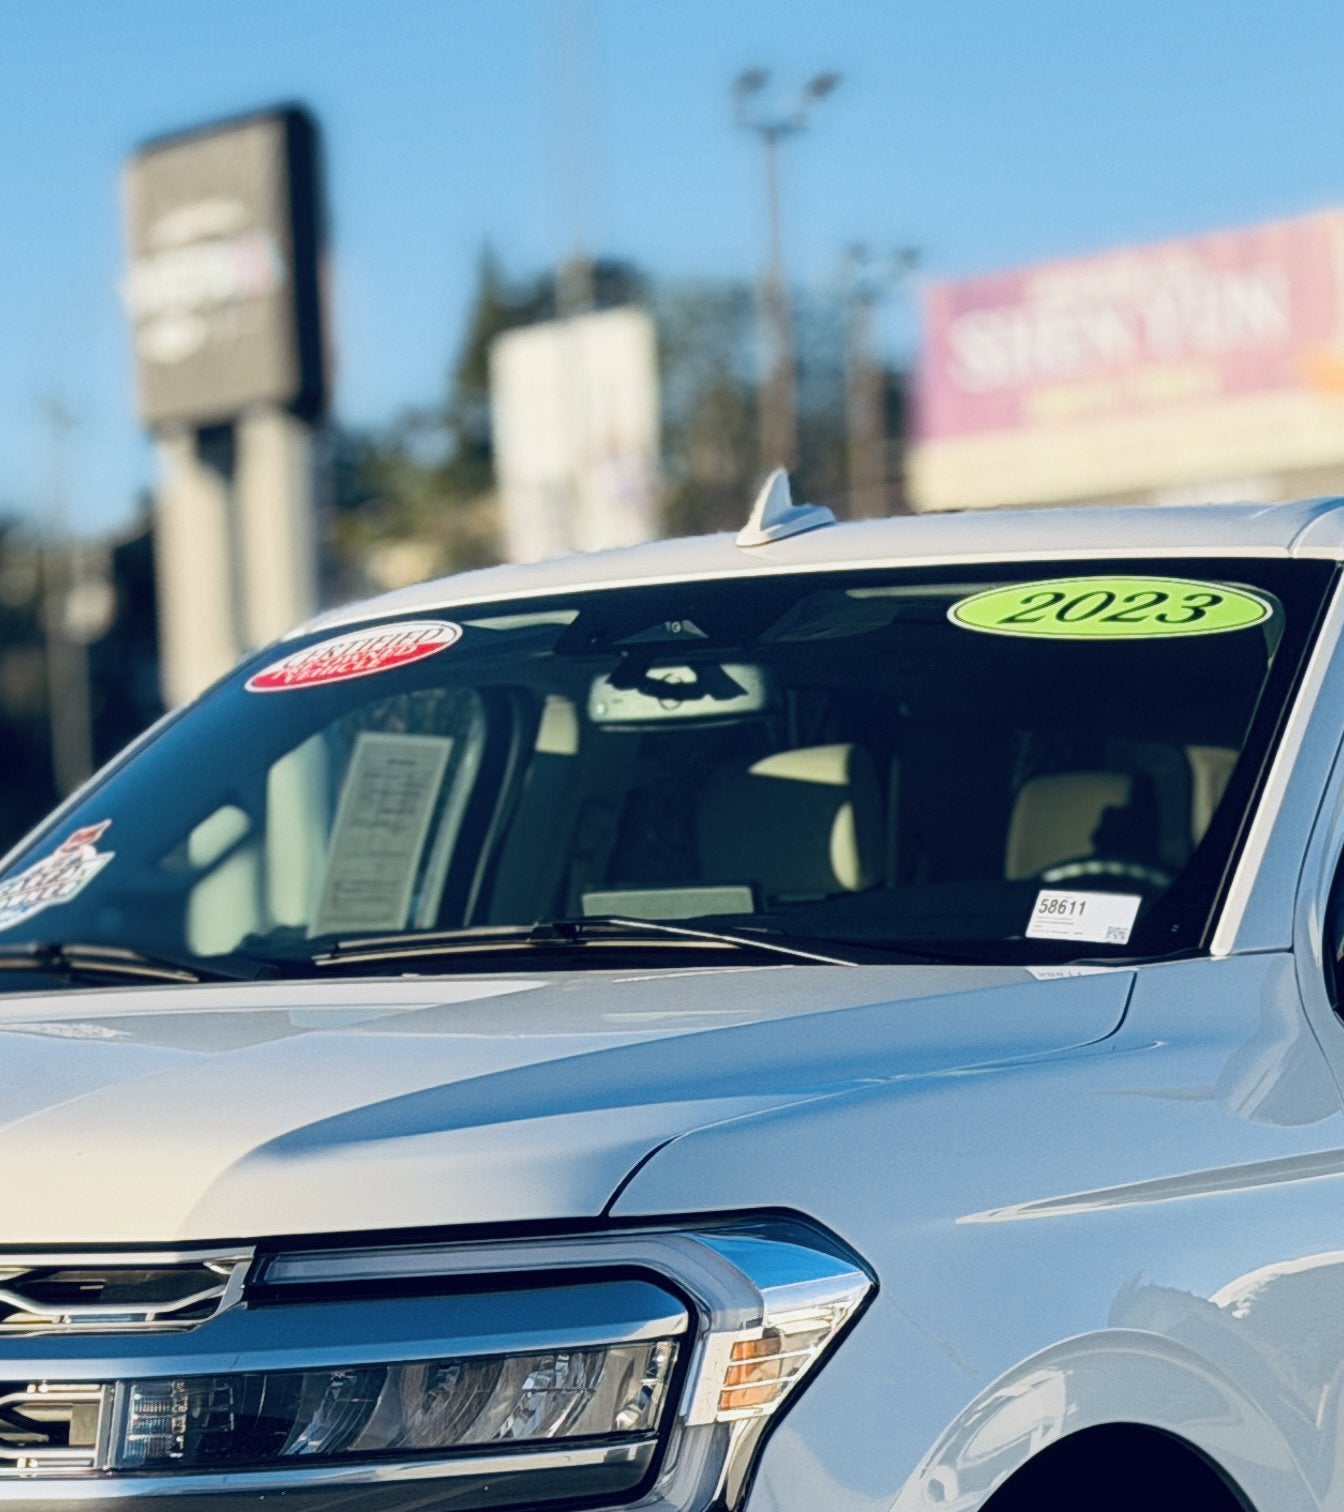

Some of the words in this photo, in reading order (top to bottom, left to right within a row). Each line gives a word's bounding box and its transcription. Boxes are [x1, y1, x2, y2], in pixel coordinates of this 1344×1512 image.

[996, 590, 1224, 625] 2023
[282, 627, 446, 669] CERTIFIED
[1038, 898, 1087, 916] 58611
